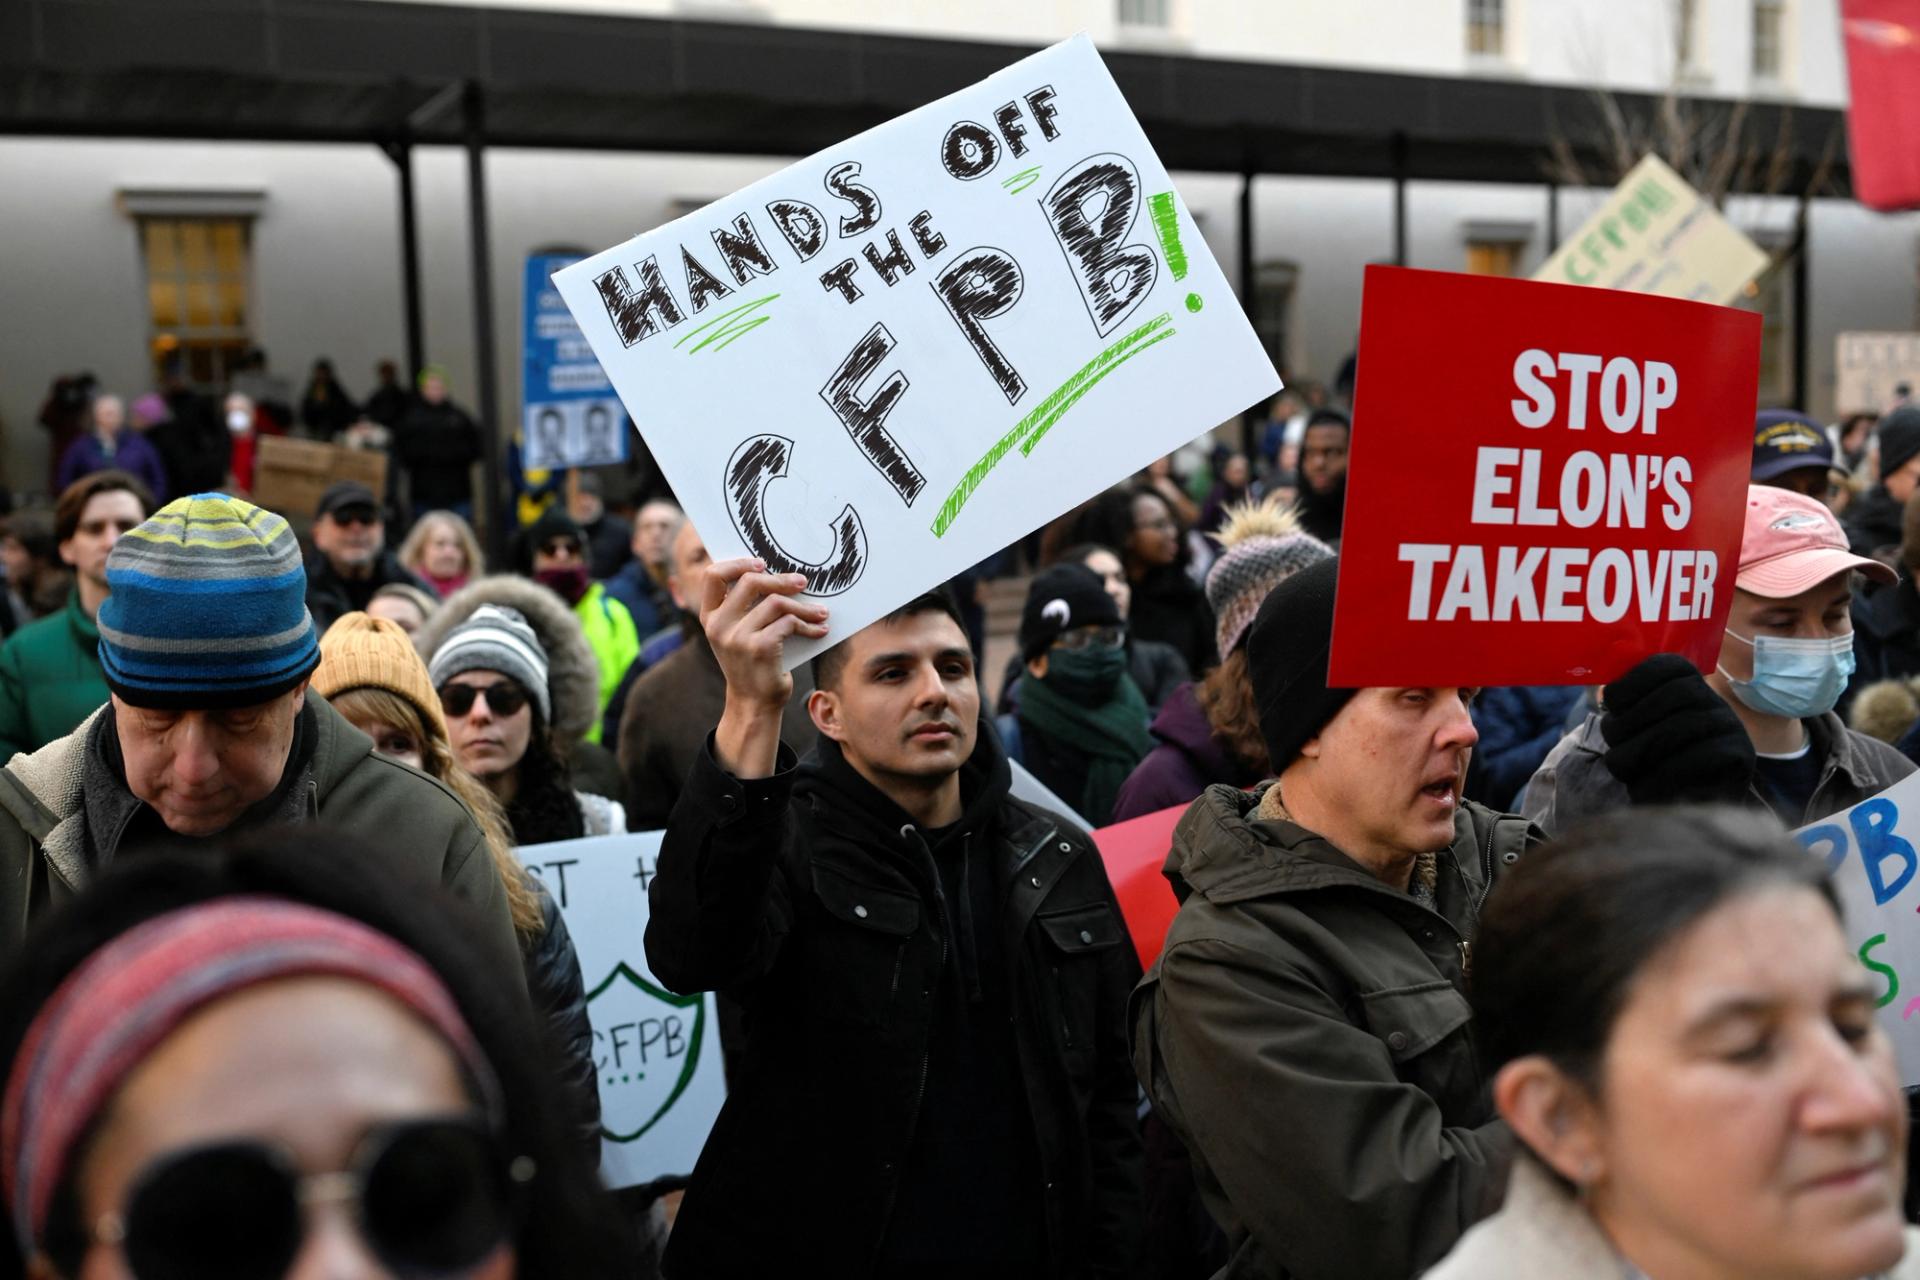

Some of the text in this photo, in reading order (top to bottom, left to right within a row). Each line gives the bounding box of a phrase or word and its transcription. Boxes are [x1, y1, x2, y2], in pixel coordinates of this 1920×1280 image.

[592, 84, 1061, 349] HANDS OFF
[820, 209, 949, 305] THE
[723, 152, 1204, 598] CFPB!
[1510, 348, 1678, 435] STOP
[1470, 446, 1693, 531] ELON'S
[1397, 543, 1719, 624] TAKEOVER
